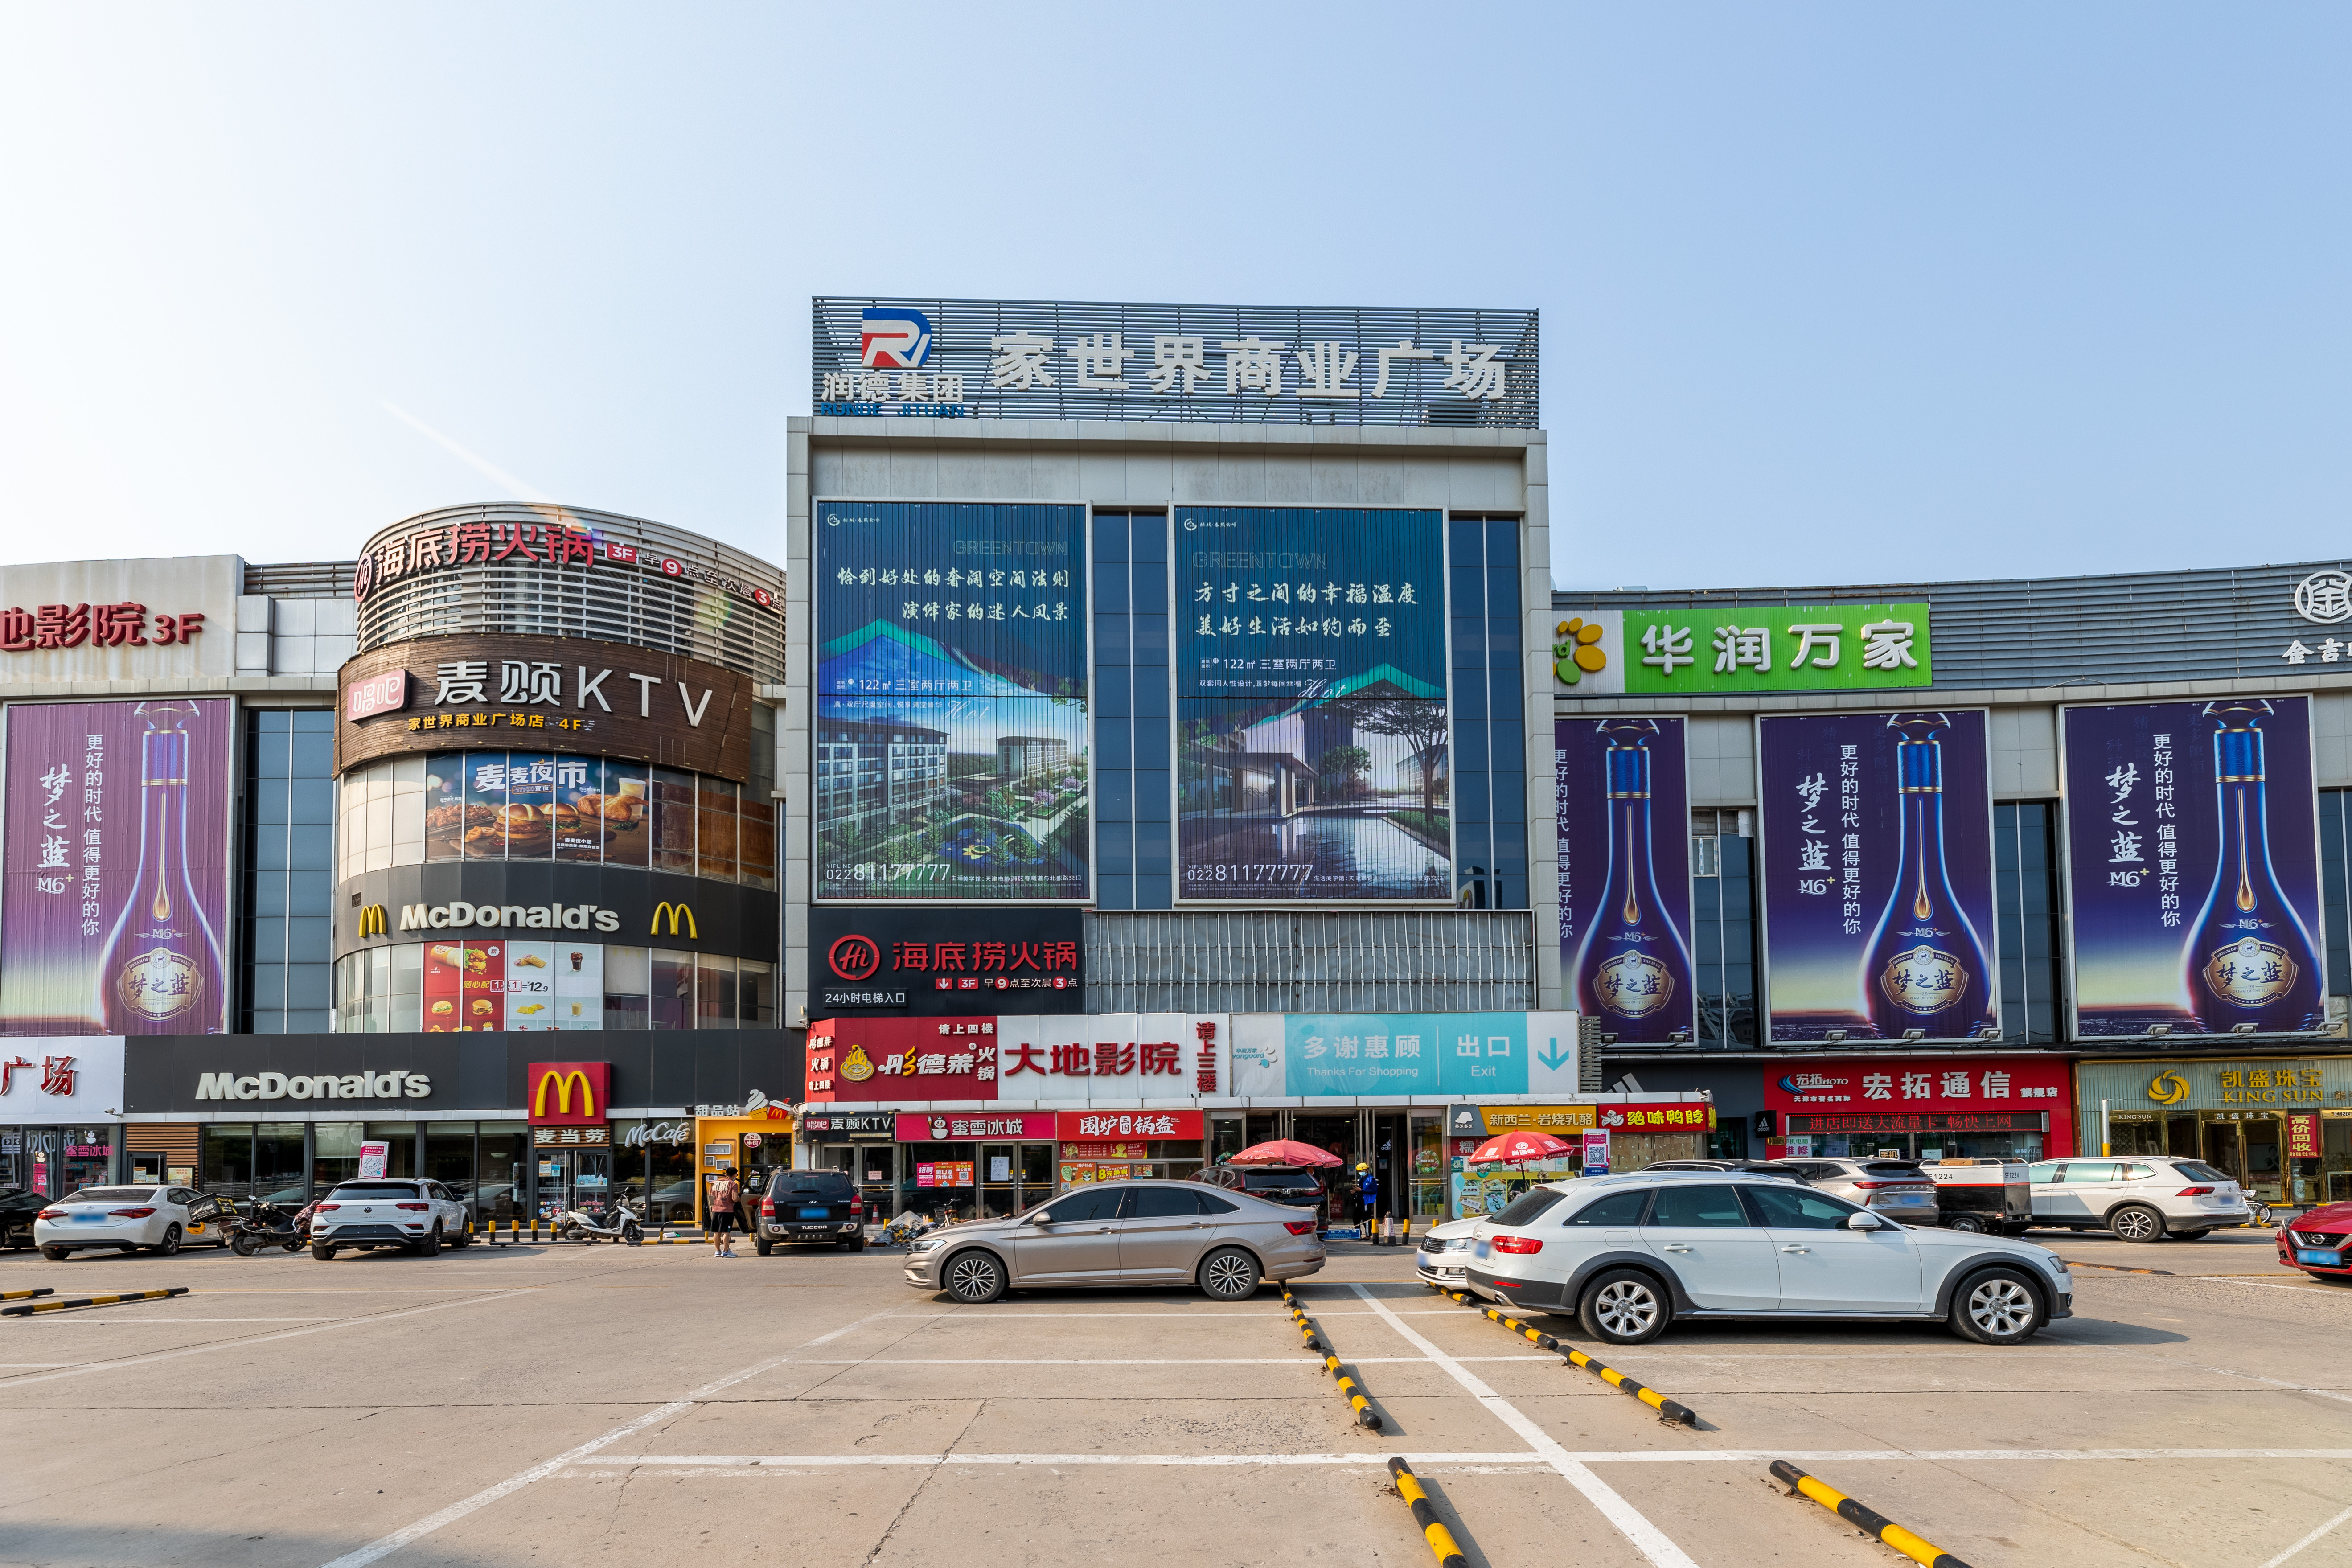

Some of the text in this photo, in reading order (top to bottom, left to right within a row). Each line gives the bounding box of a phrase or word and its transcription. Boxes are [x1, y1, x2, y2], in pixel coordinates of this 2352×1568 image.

[990, 332, 1505, 401] 家世界商业广场
[821, 372, 963, 403] 润德集团
[821, 403, 964, 417] RUNDE JITUAN
[375, 522, 595, 585] 海底捞火锅
[611, 545, 633, 560] 3F
[954, 541, 1067, 555] GREENTOWN
[1193, 552, 1327, 569] GREENTOWN
[1195, 582, 1419, 605] 方寸之间的幸福温度
[903, 602, 1067, 622] 演绎家的迷人风景
[152, 613, 205, 645] 3F
[1196, 614, 1391, 637] 美好生活如约而至
[1640, 618, 1919, 677] 华润万家
[2282, 637, 2352, 664] 金吉
[1260, 659, 1336, 670] 三室两厅两卫
[352, 676, 401, 714] 唱吧
[895, 680, 972, 691] 三室两厅两卫
[407, 713, 582, 731] 家世界商业广场店 4F
[475, 761, 587, 793] 麦麦夜市
[37, 763, 72, 868] 梦之蓝
[1795, 772, 1831, 871] 梦之蓝
[2105, 762, 2144, 863] 梦之蓝
[81, 734, 103, 936] 更好的时代 值得更好的你
[1840, 745, 1861, 935] 更好的时代 值得更好的你
[2153, 734, 2181, 927] 更好的时代 值得更好的你
[399, 901, 620, 932] McDonald's
[892, 941, 1078, 972] 海底捞火锅
[463, 980, 490, 989] 随心配
[961, 980, 976, 988] 3F
[1892, 969, 1955, 995] 梦之蓝
[2216, 961, 2284, 989] 梦之蓝
[127, 973, 191, 1001] 梦之蓝
[1603, 973, 1662, 1000] 梦之蓝
[825, 992, 905, 1004] 24小时电梯入口
[938, 1023, 994, 1035] 请上四楼
[1196, 1021, 1217, 1092] 请上三楼
[1303, 1034, 1421, 1059] 多谢惠顾
[1457, 1034, 1510, 1058] 出口
[811, 1056, 832, 1073] 火锅
[1004, 1041, 1181, 1076] 大地影院
[0, 1055, 78, 1097] 广场
[1307, 1067, 1419, 1079] Thanks For Shopping
[1471, 1065, 1496, 1077] Exit
[1795, 1074, 1822, 1086] 宏拓
[2220, 1069, 2323, 1088] 凯盛珠宝
[195, 1070, 431, 1100] McDonald's
[808, 1079, 833, 1091] 请上四楼
[1862, 1071, 2011, 1100] 宏拓通信
[2020, 1087, 2058, 1099] 旗舰店
[2224, 1090, 2323, 1103] KING SUN
[695, 1104, 740, 1117] 甜品站
[1490, 1112, 1593, 1127] 新西兰·岩烧乳酪
[1627, 1109, 1704, 1126] 绝味鸭脖
[807, 1120, 827, 1129] 唱吧
[951, 1118, 1023, 1136] 蜜雪冰城
[1809, 1114, 2011, 1131] 进店即送大流量卡 畅快上网
[535, 1129, 606, 1144] 麦当劳
[625, 1122, 690, 1147] McCafé
[2290, 1115, 2312, 1152] 高价回收
[65, 1145, 114, 1157] 蜜雪冰城
[1786, 1145, 1808, 1155] 维修
[1880, 1150, 1899, 1159] 手机
[918, 1166, 934, 1175] 招聘
